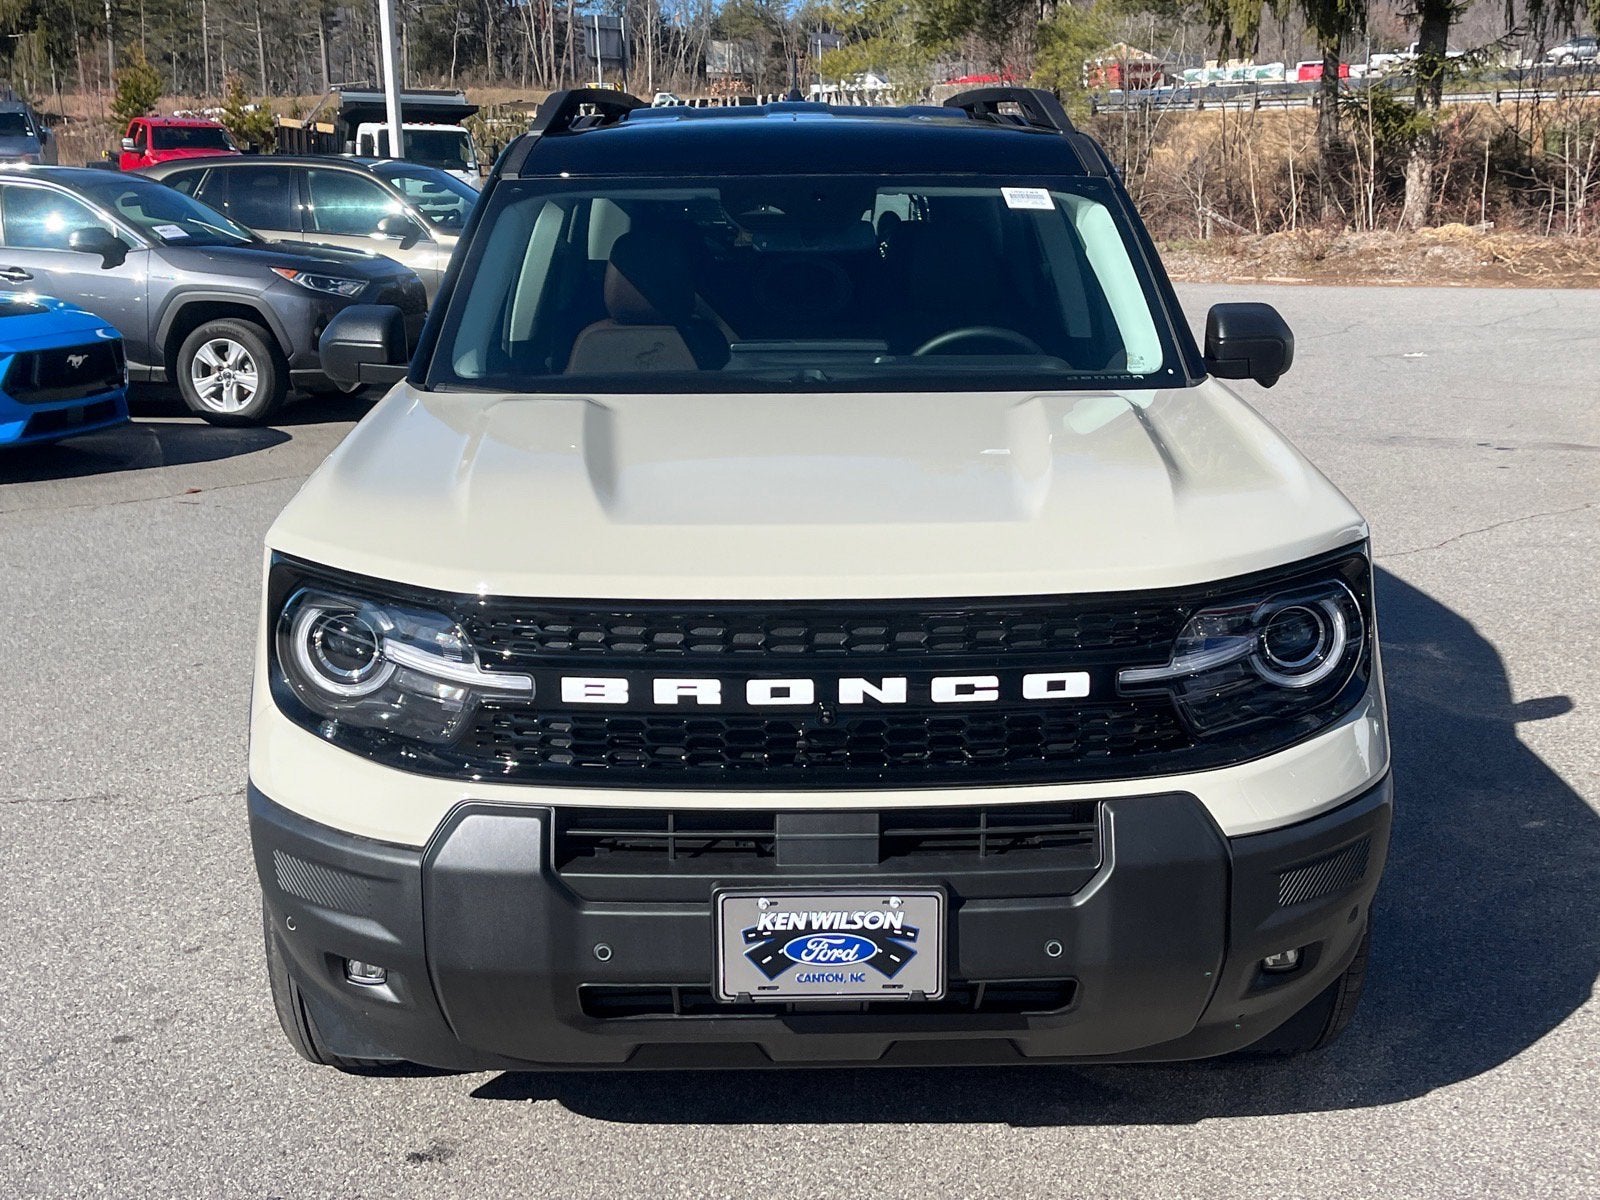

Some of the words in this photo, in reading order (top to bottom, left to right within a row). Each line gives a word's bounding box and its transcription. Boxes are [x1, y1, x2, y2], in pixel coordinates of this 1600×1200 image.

[561, 671, 1090, 704] BRONCO
[800, 937, 861, 962] Ford
[795, 972, 847, 984] CANTON,
[849, 972, 866, 983] NC
